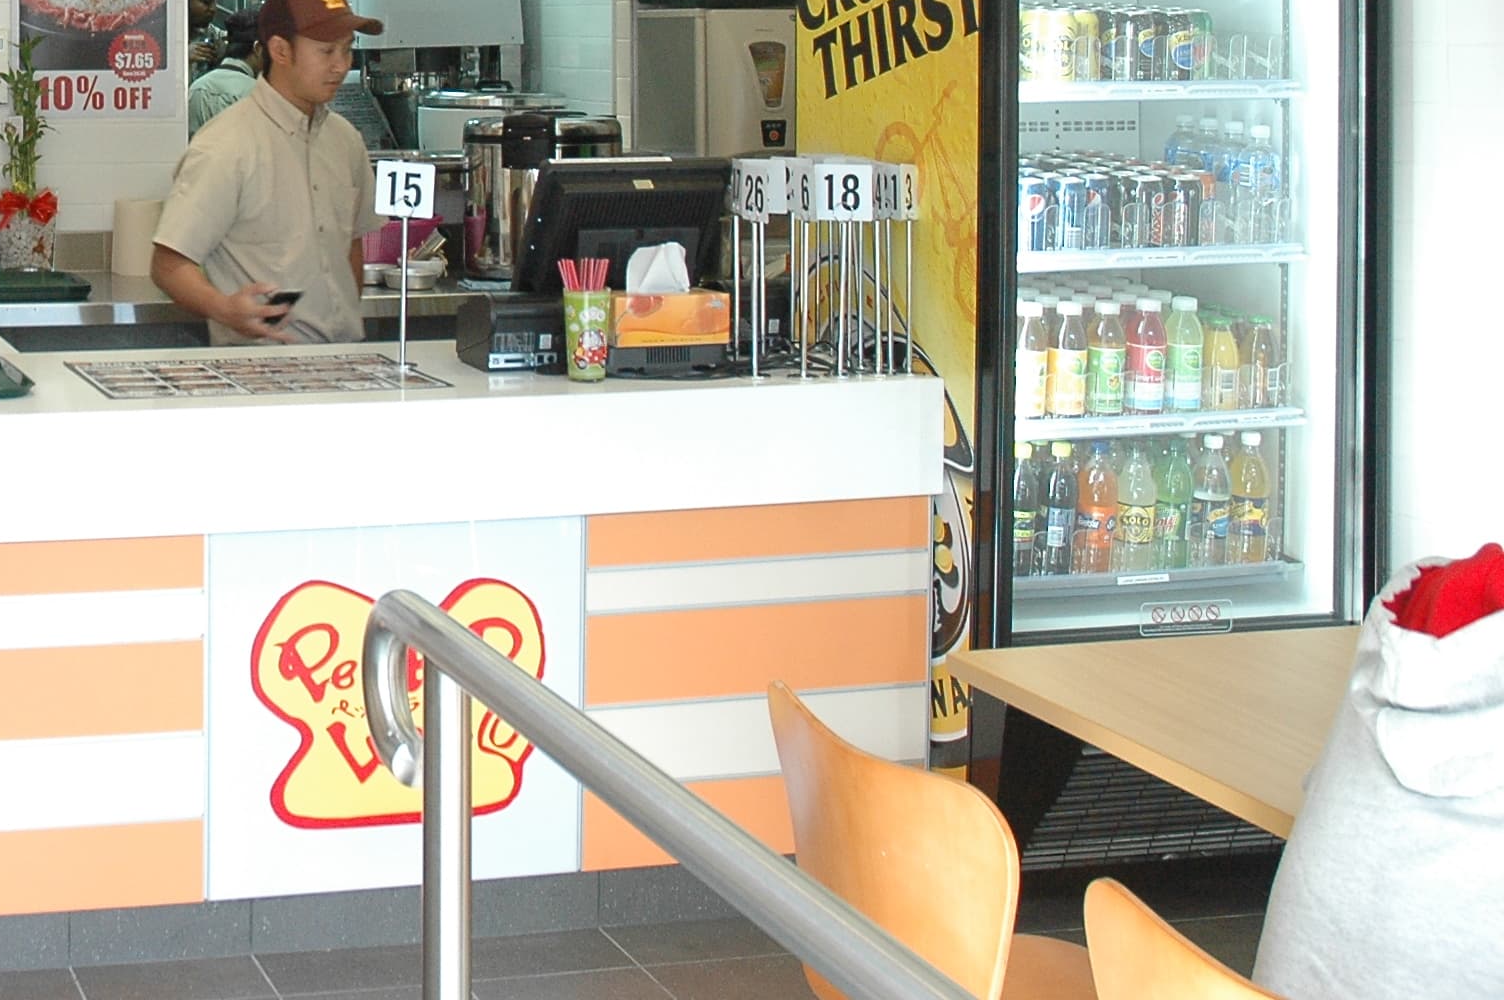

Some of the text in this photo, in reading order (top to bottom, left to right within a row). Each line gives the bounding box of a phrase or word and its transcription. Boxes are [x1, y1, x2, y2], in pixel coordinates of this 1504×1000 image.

[114, 52, 153, 70] $7.65
[39, 75, 152, 111] 10% OFF
[387, 171, 422, 208] 15
[745, 174, 764, 213] 26
[800, 173, 810, 211] 6
[824, 173, 860, 211] 18
[905, 173, 912, 211] 3
[1122, 516, 1150, 527] SOLO
